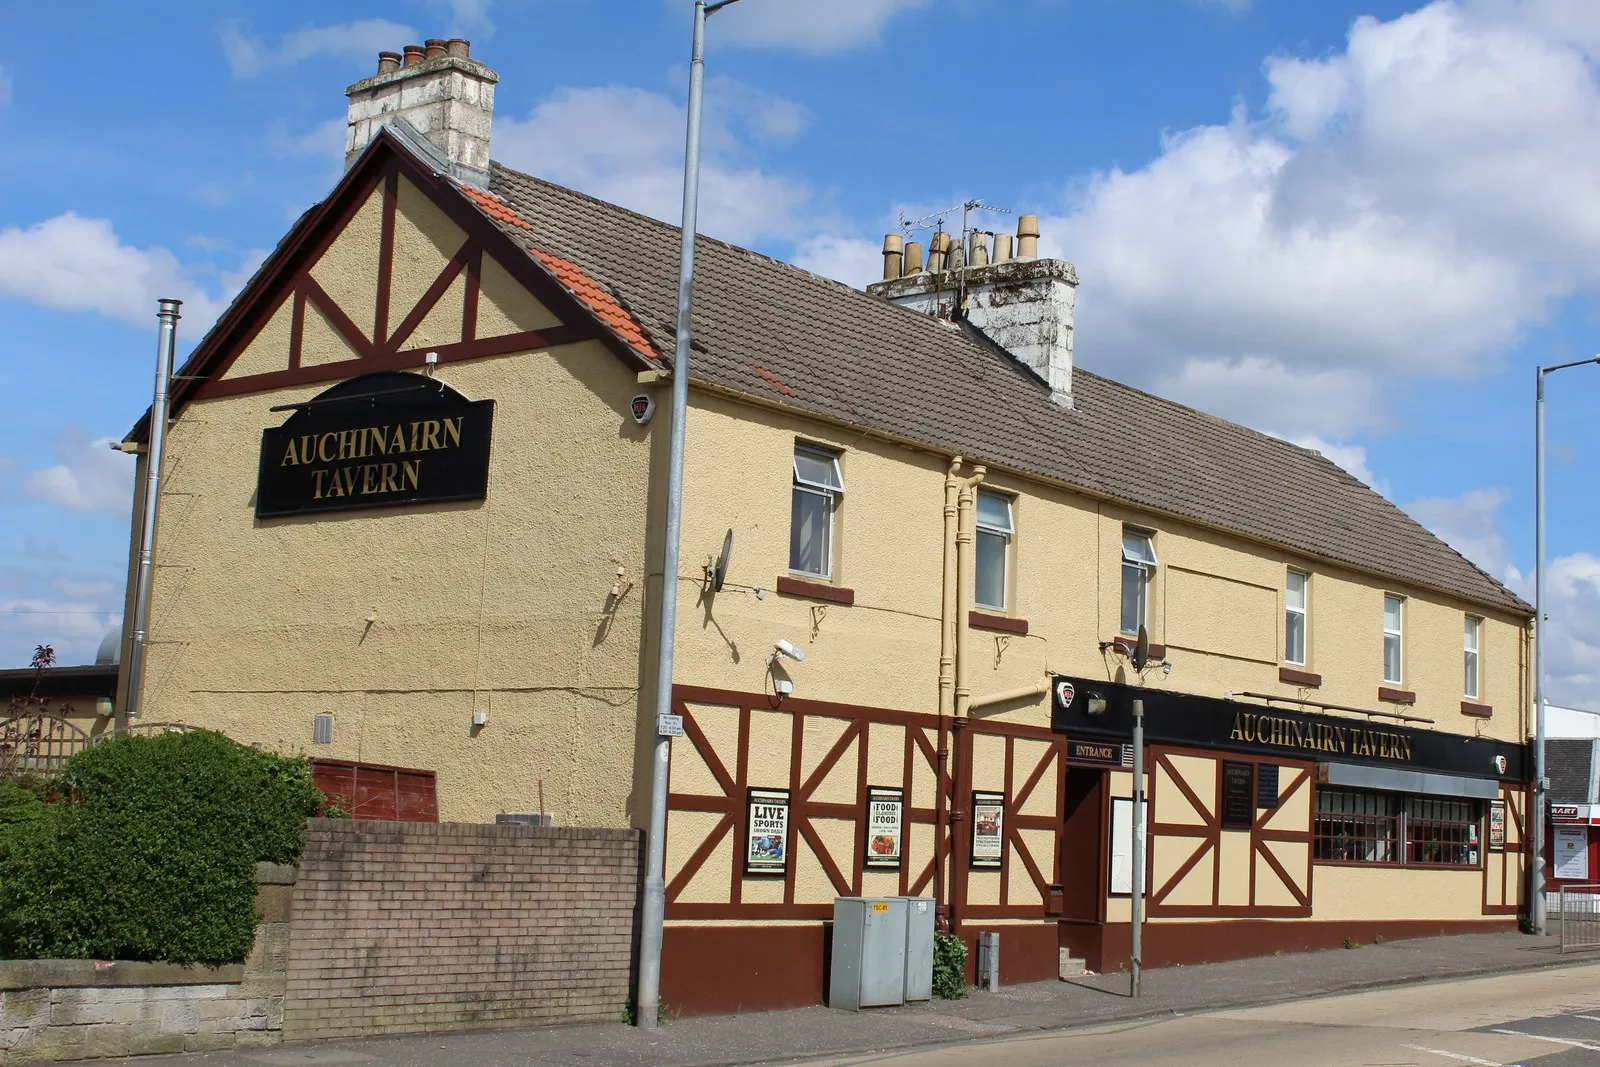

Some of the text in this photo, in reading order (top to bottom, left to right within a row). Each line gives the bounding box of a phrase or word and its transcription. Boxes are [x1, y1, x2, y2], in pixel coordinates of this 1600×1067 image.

[280, 416, 464, 467] AUCHINAIRN
[311, 459, 422, 500] TAVERN
[1230, 712, 1411, 760] AUCHINAIRN TAVERN
[1076, 745, 1112, 758] ENTRANCE
[754, 806, 784, 820] LIVE
[875, 803, 896, 811] FOOD
[754, 819, 783, 828] SPORTS
